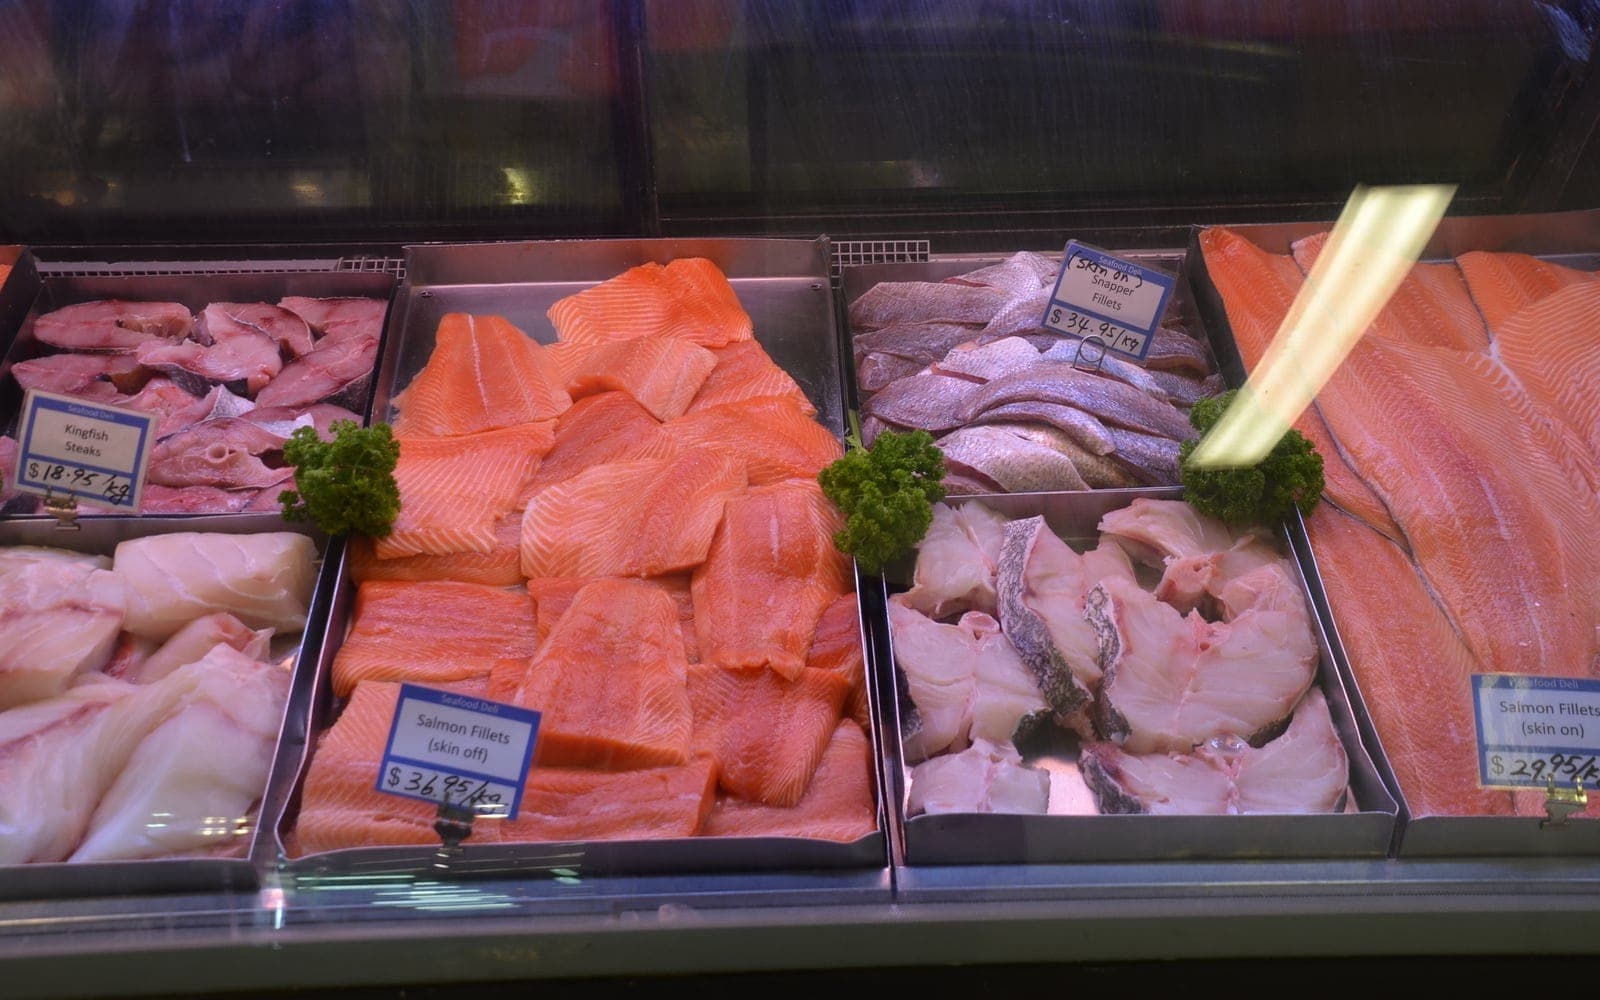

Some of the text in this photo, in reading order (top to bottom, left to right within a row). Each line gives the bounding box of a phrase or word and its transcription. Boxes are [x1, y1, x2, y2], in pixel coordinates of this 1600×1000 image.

[1092, 275, 1134, 297] Snapper
[1092, 292, 1122, 311] Fillets
[64, 424, 109, 442] Kingfish
[64, 442, 102, 457] Steaks
[1516, 678, 1579, 689] food Deli
[441, 693, 479, 710] Seafood
[1500, 700, 1600, 717] Salmon Fillets
[416, 713, 511, 745] Salmon Fillets
[1521, 722, 1585, 738] (skin on)
[428, 738, 489, 764] (skin off)
